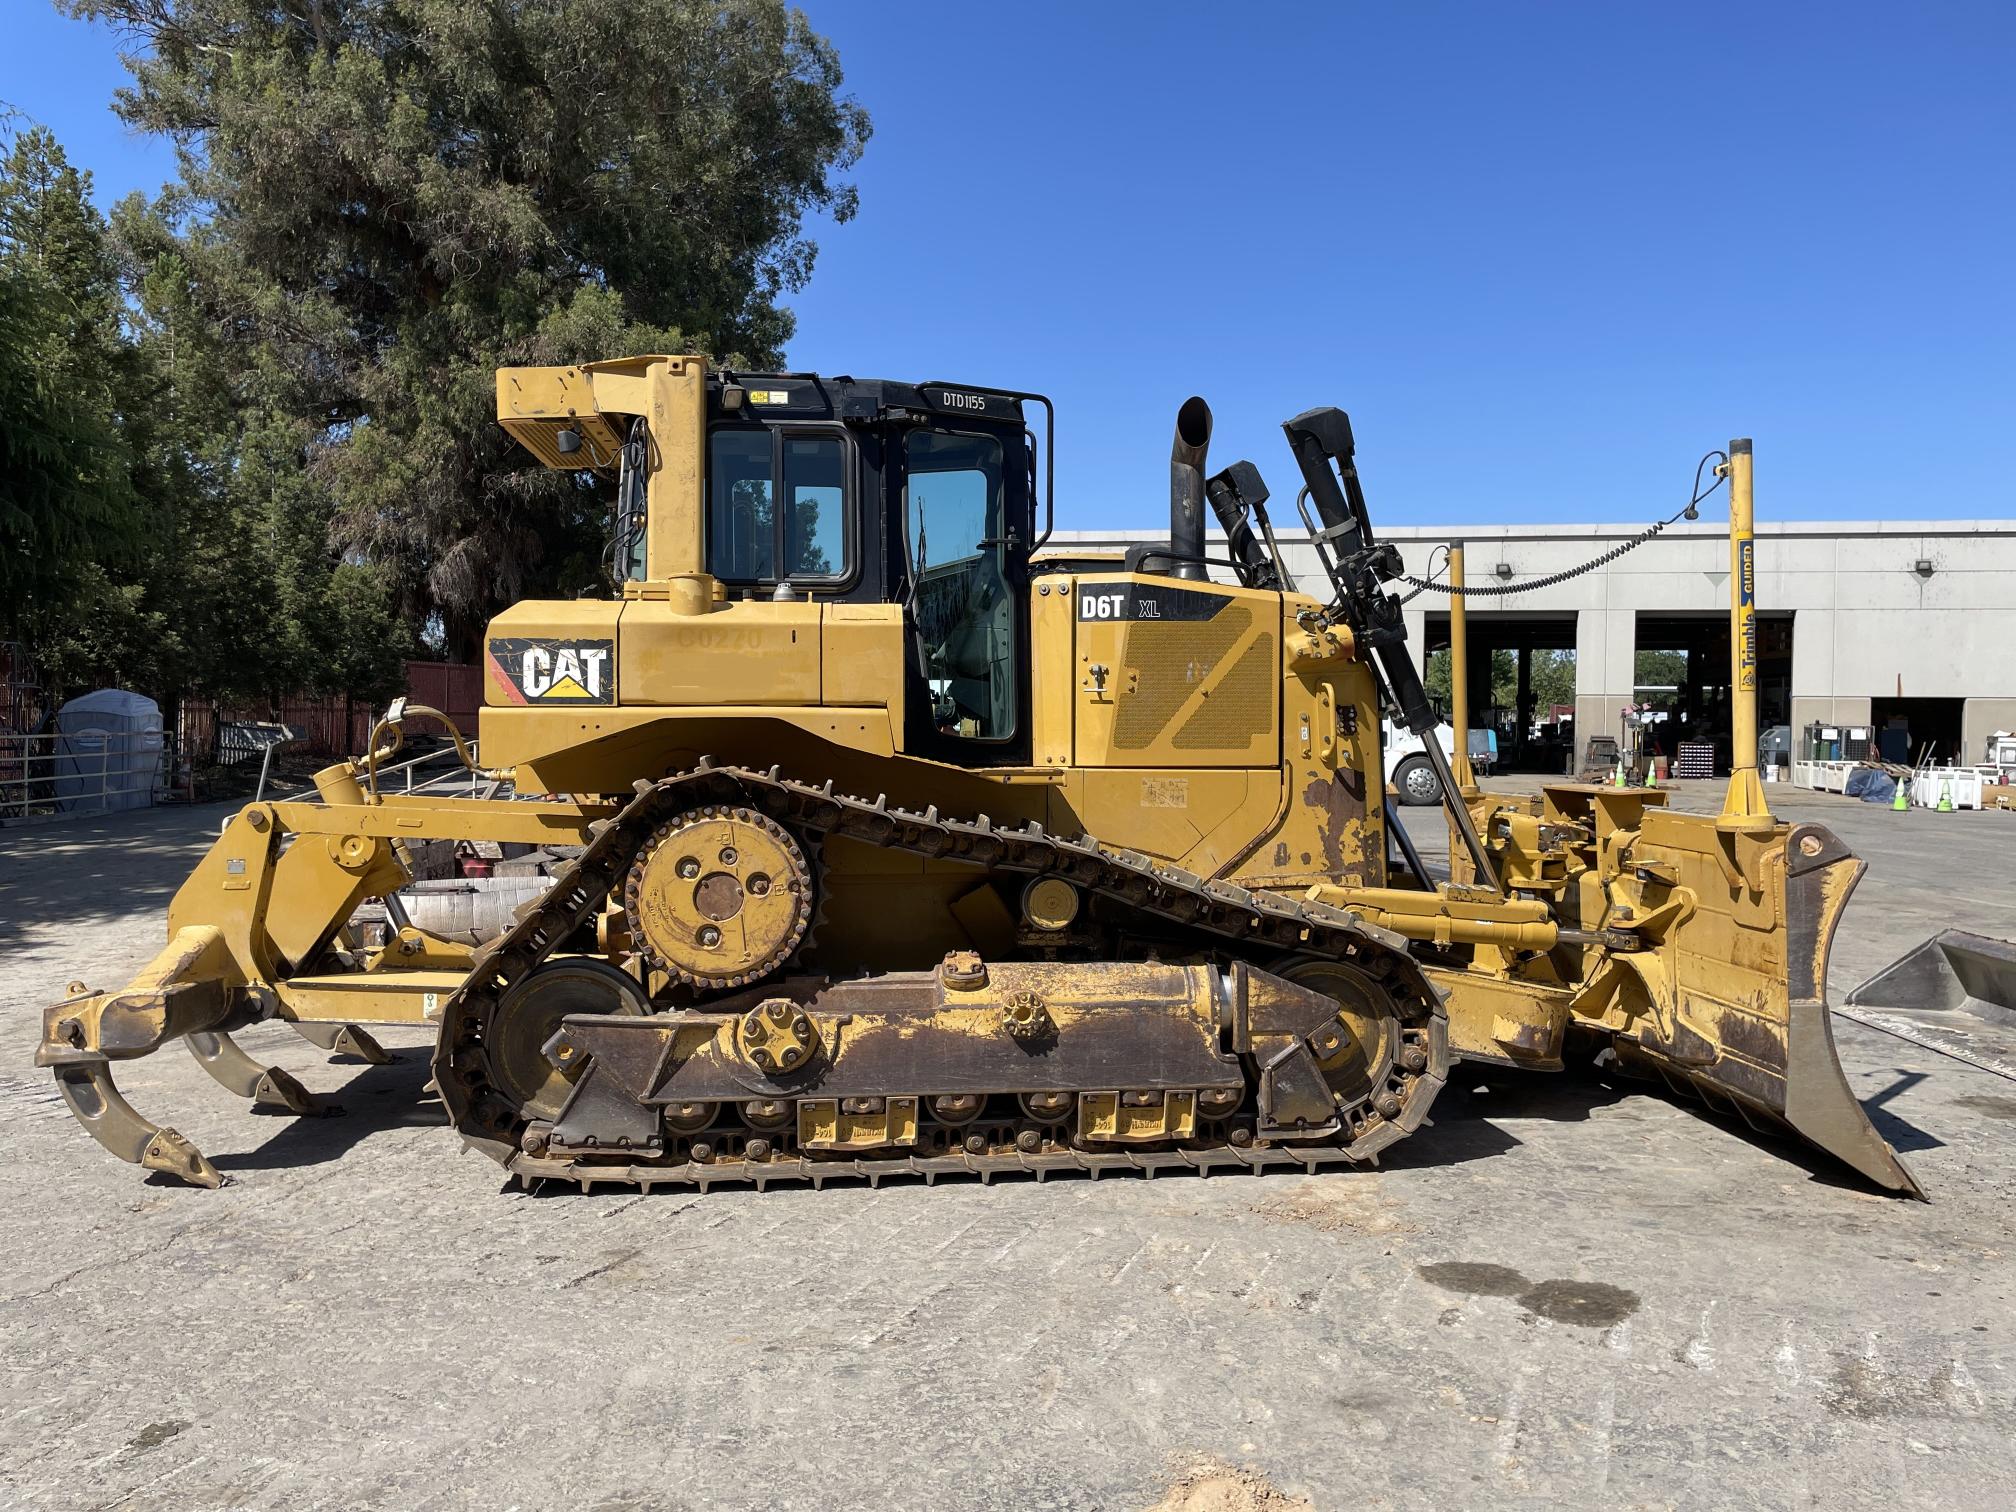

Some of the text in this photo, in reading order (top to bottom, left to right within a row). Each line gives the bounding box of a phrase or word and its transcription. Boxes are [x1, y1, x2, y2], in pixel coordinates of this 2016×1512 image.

[943, 392, 986, 410] DTD1155
[1743, 545, 1752, 593] GUIDED
[1082, 595, 1161, 618] D6T XL
[1742, 613, 1756, 669] Trimble
[522, 648, 607, 698] CAT
